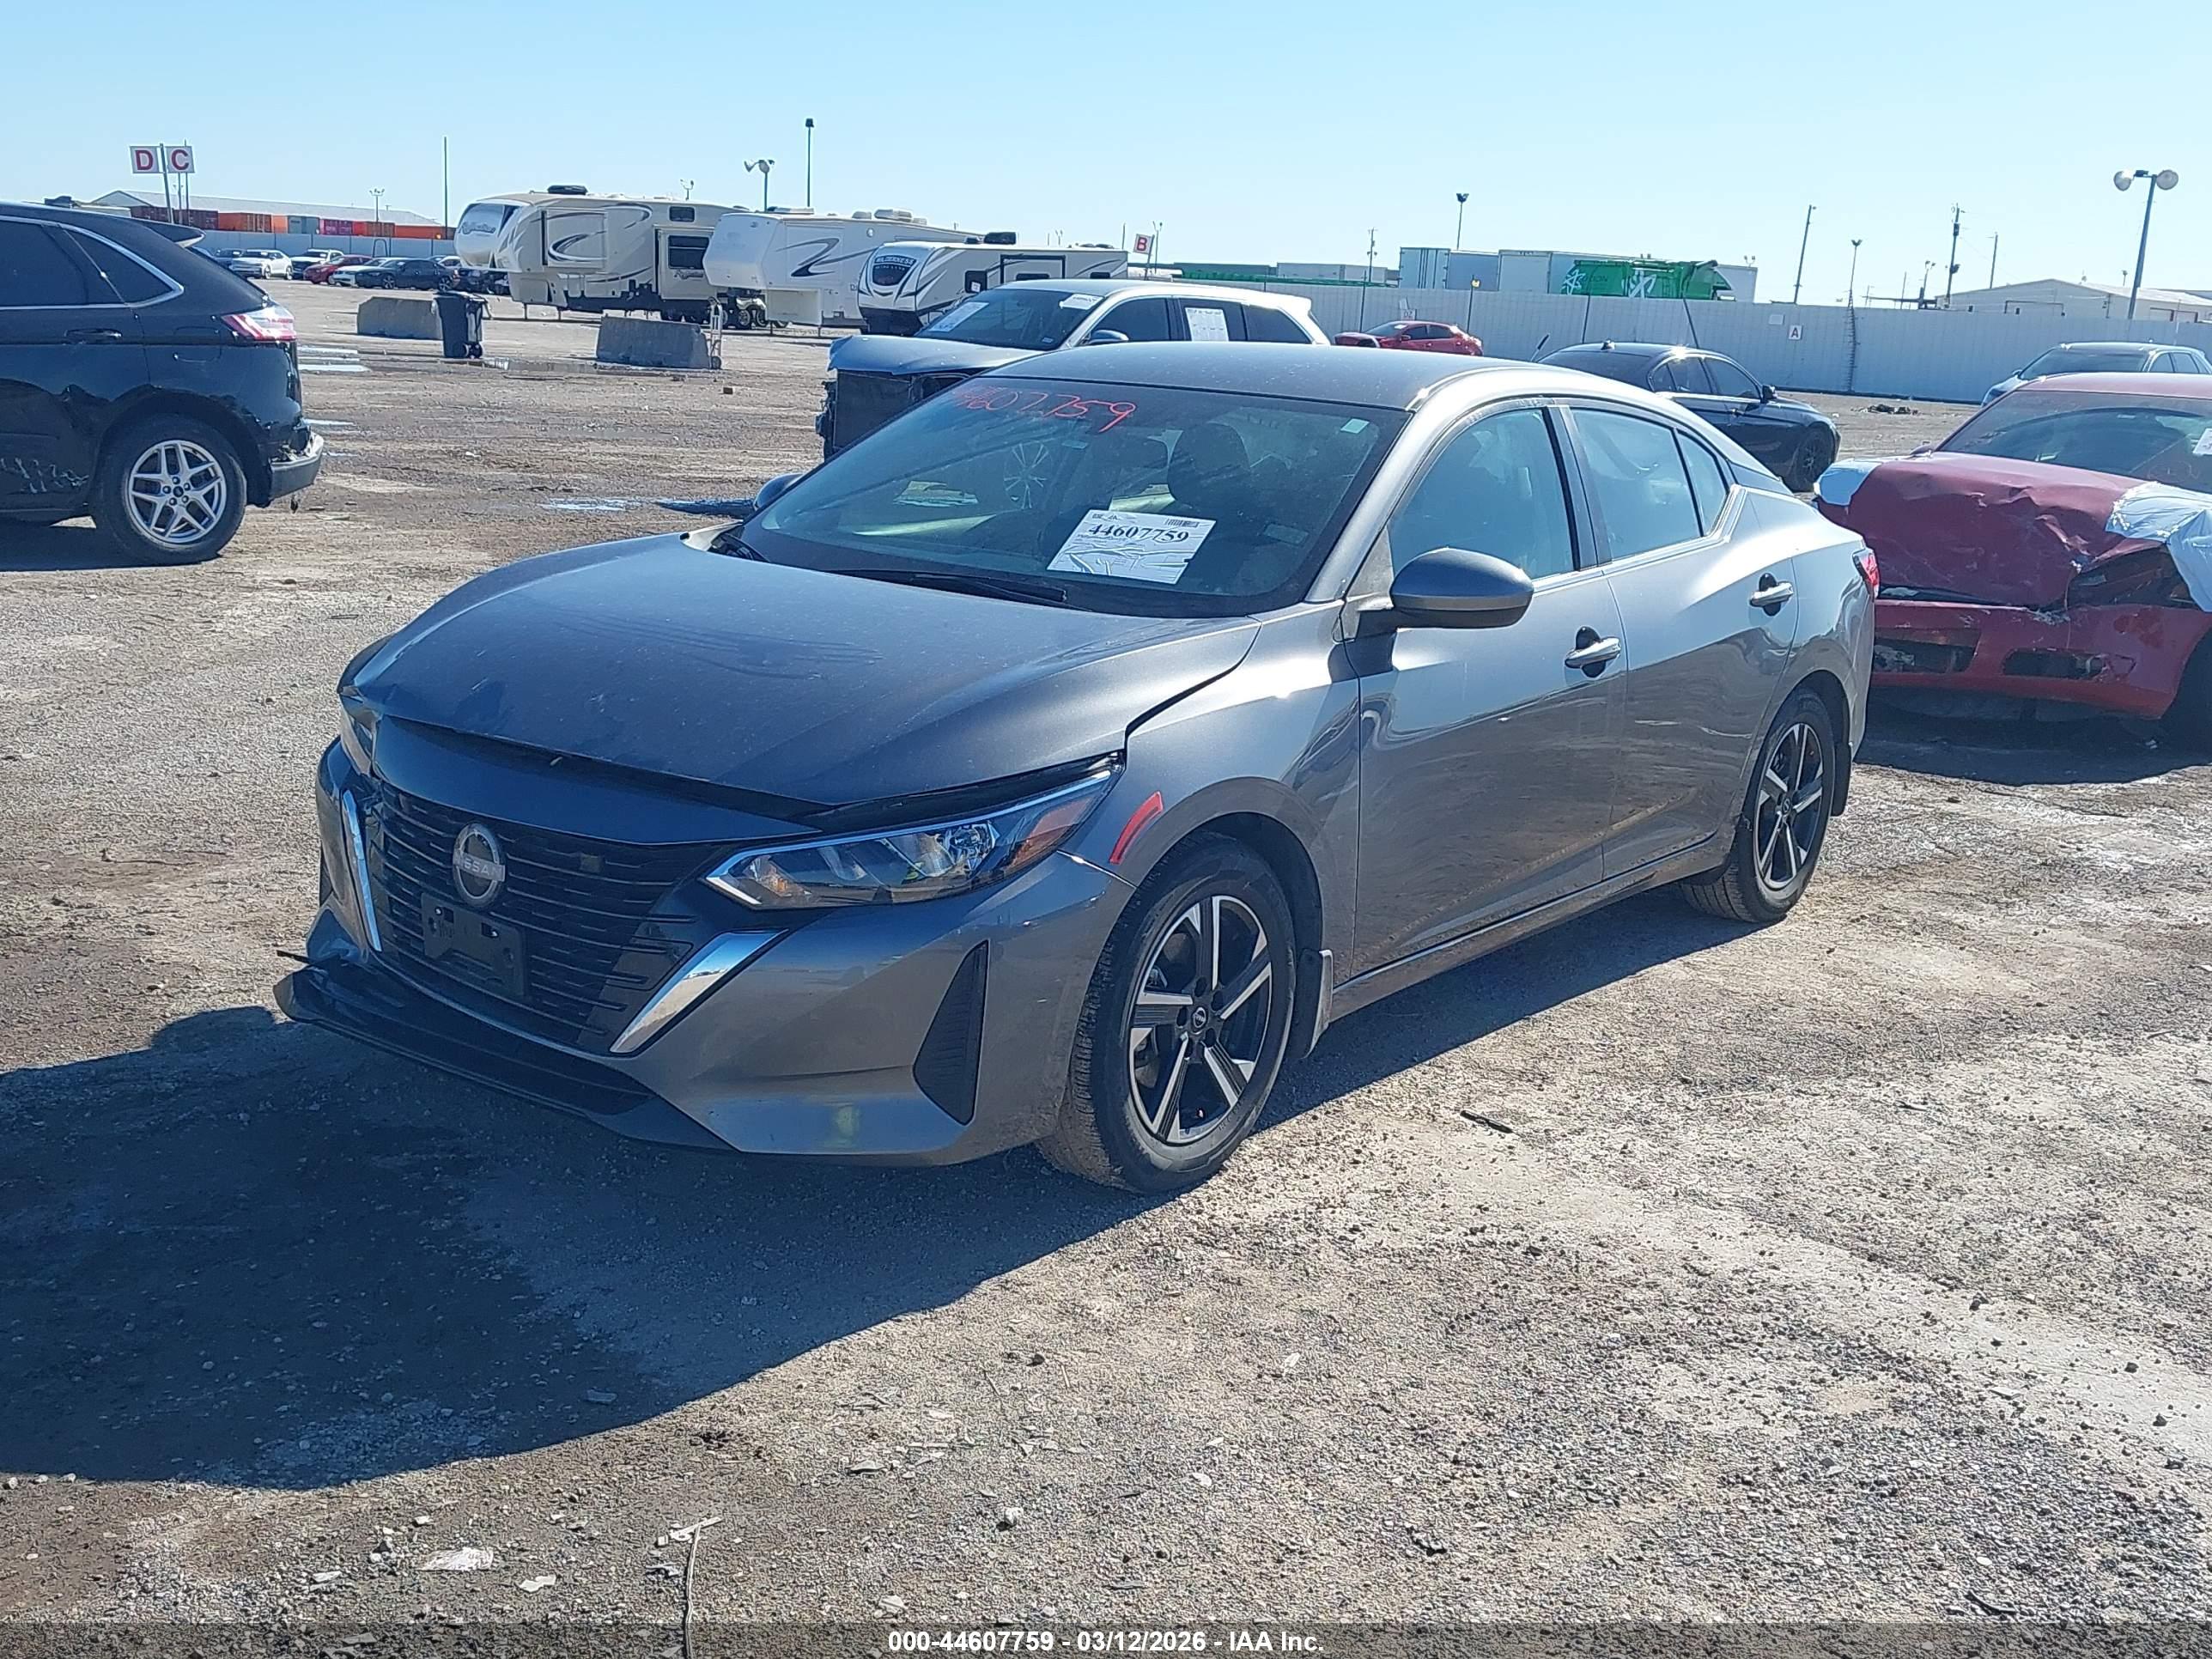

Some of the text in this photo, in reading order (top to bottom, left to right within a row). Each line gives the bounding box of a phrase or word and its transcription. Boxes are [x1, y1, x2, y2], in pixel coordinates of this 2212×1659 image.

[135, 149, 154, 171] D
[171, 149, 190, 171] C
[1136, 236, 1148, 251] B
[1790, 326, 1800, 338] A
[1088, 523, 1189, 543] 44607759
